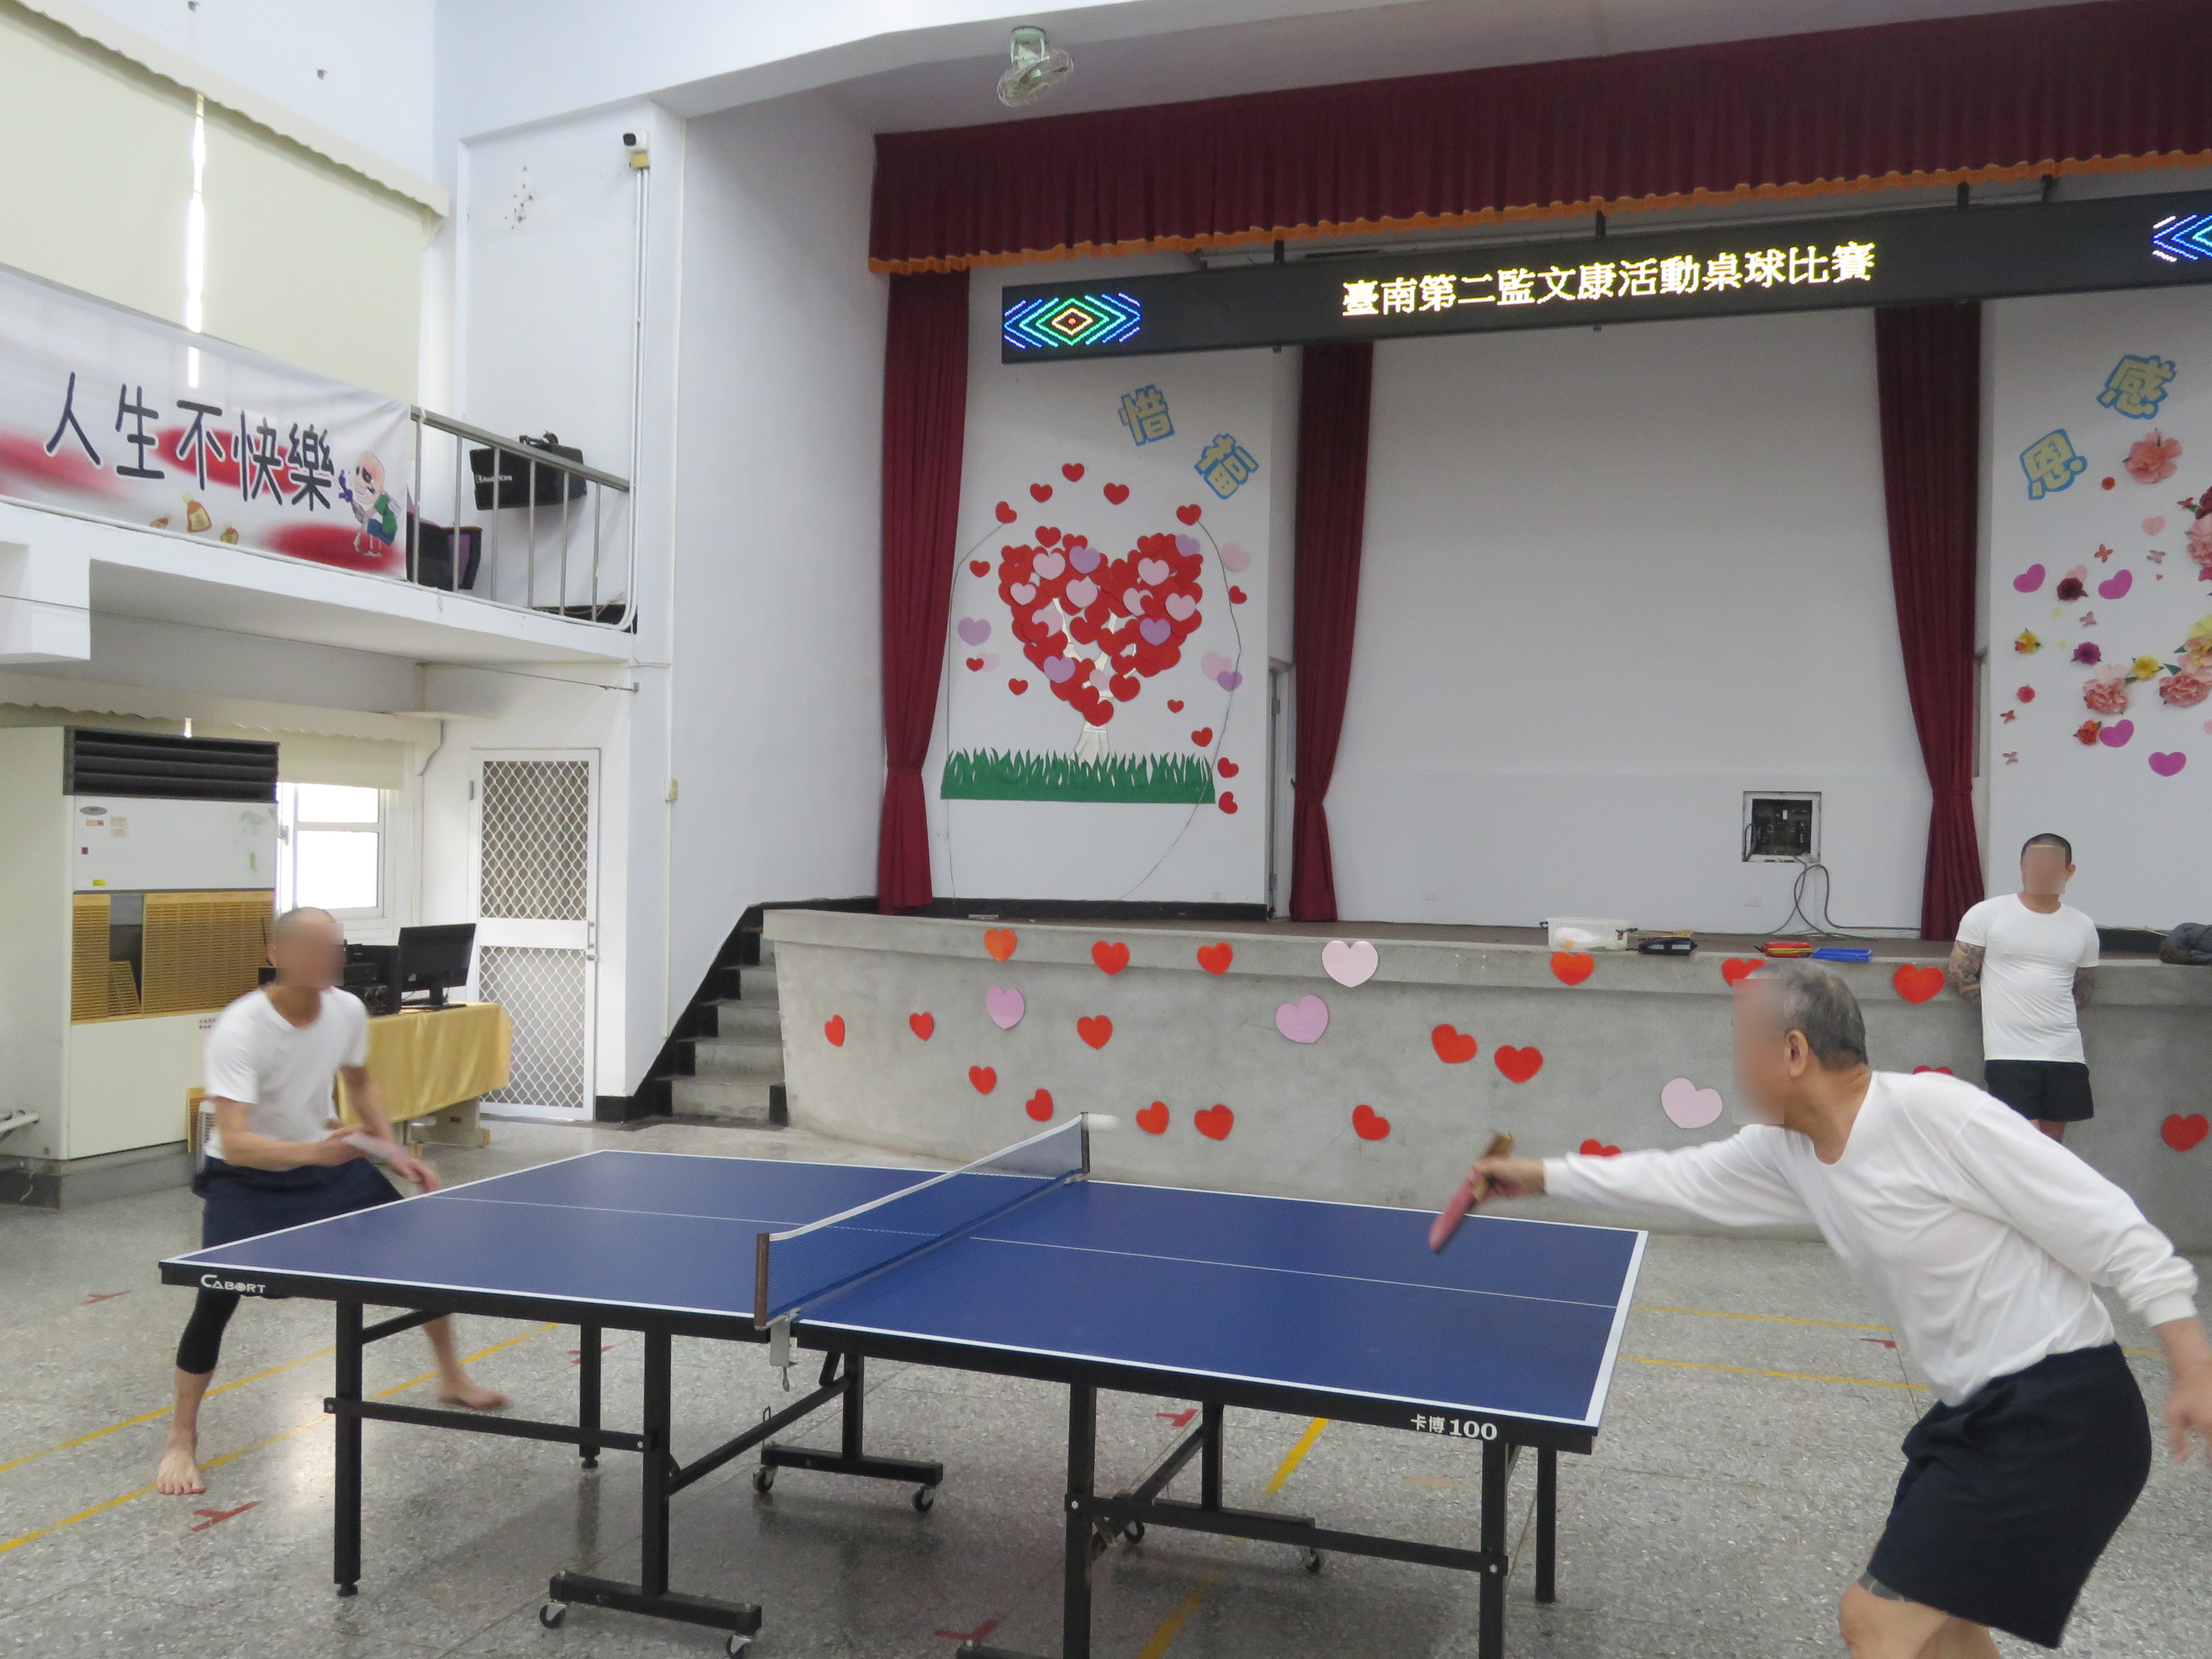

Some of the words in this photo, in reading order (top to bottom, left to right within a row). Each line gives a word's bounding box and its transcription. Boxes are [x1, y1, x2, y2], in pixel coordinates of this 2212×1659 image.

[1342, 240, 1875, 317] 臺南第二監文康活動桌球比賽
[44, 371, 335, 511] 人生不快樂
[200, 1274, 266, 1293] CABORT
